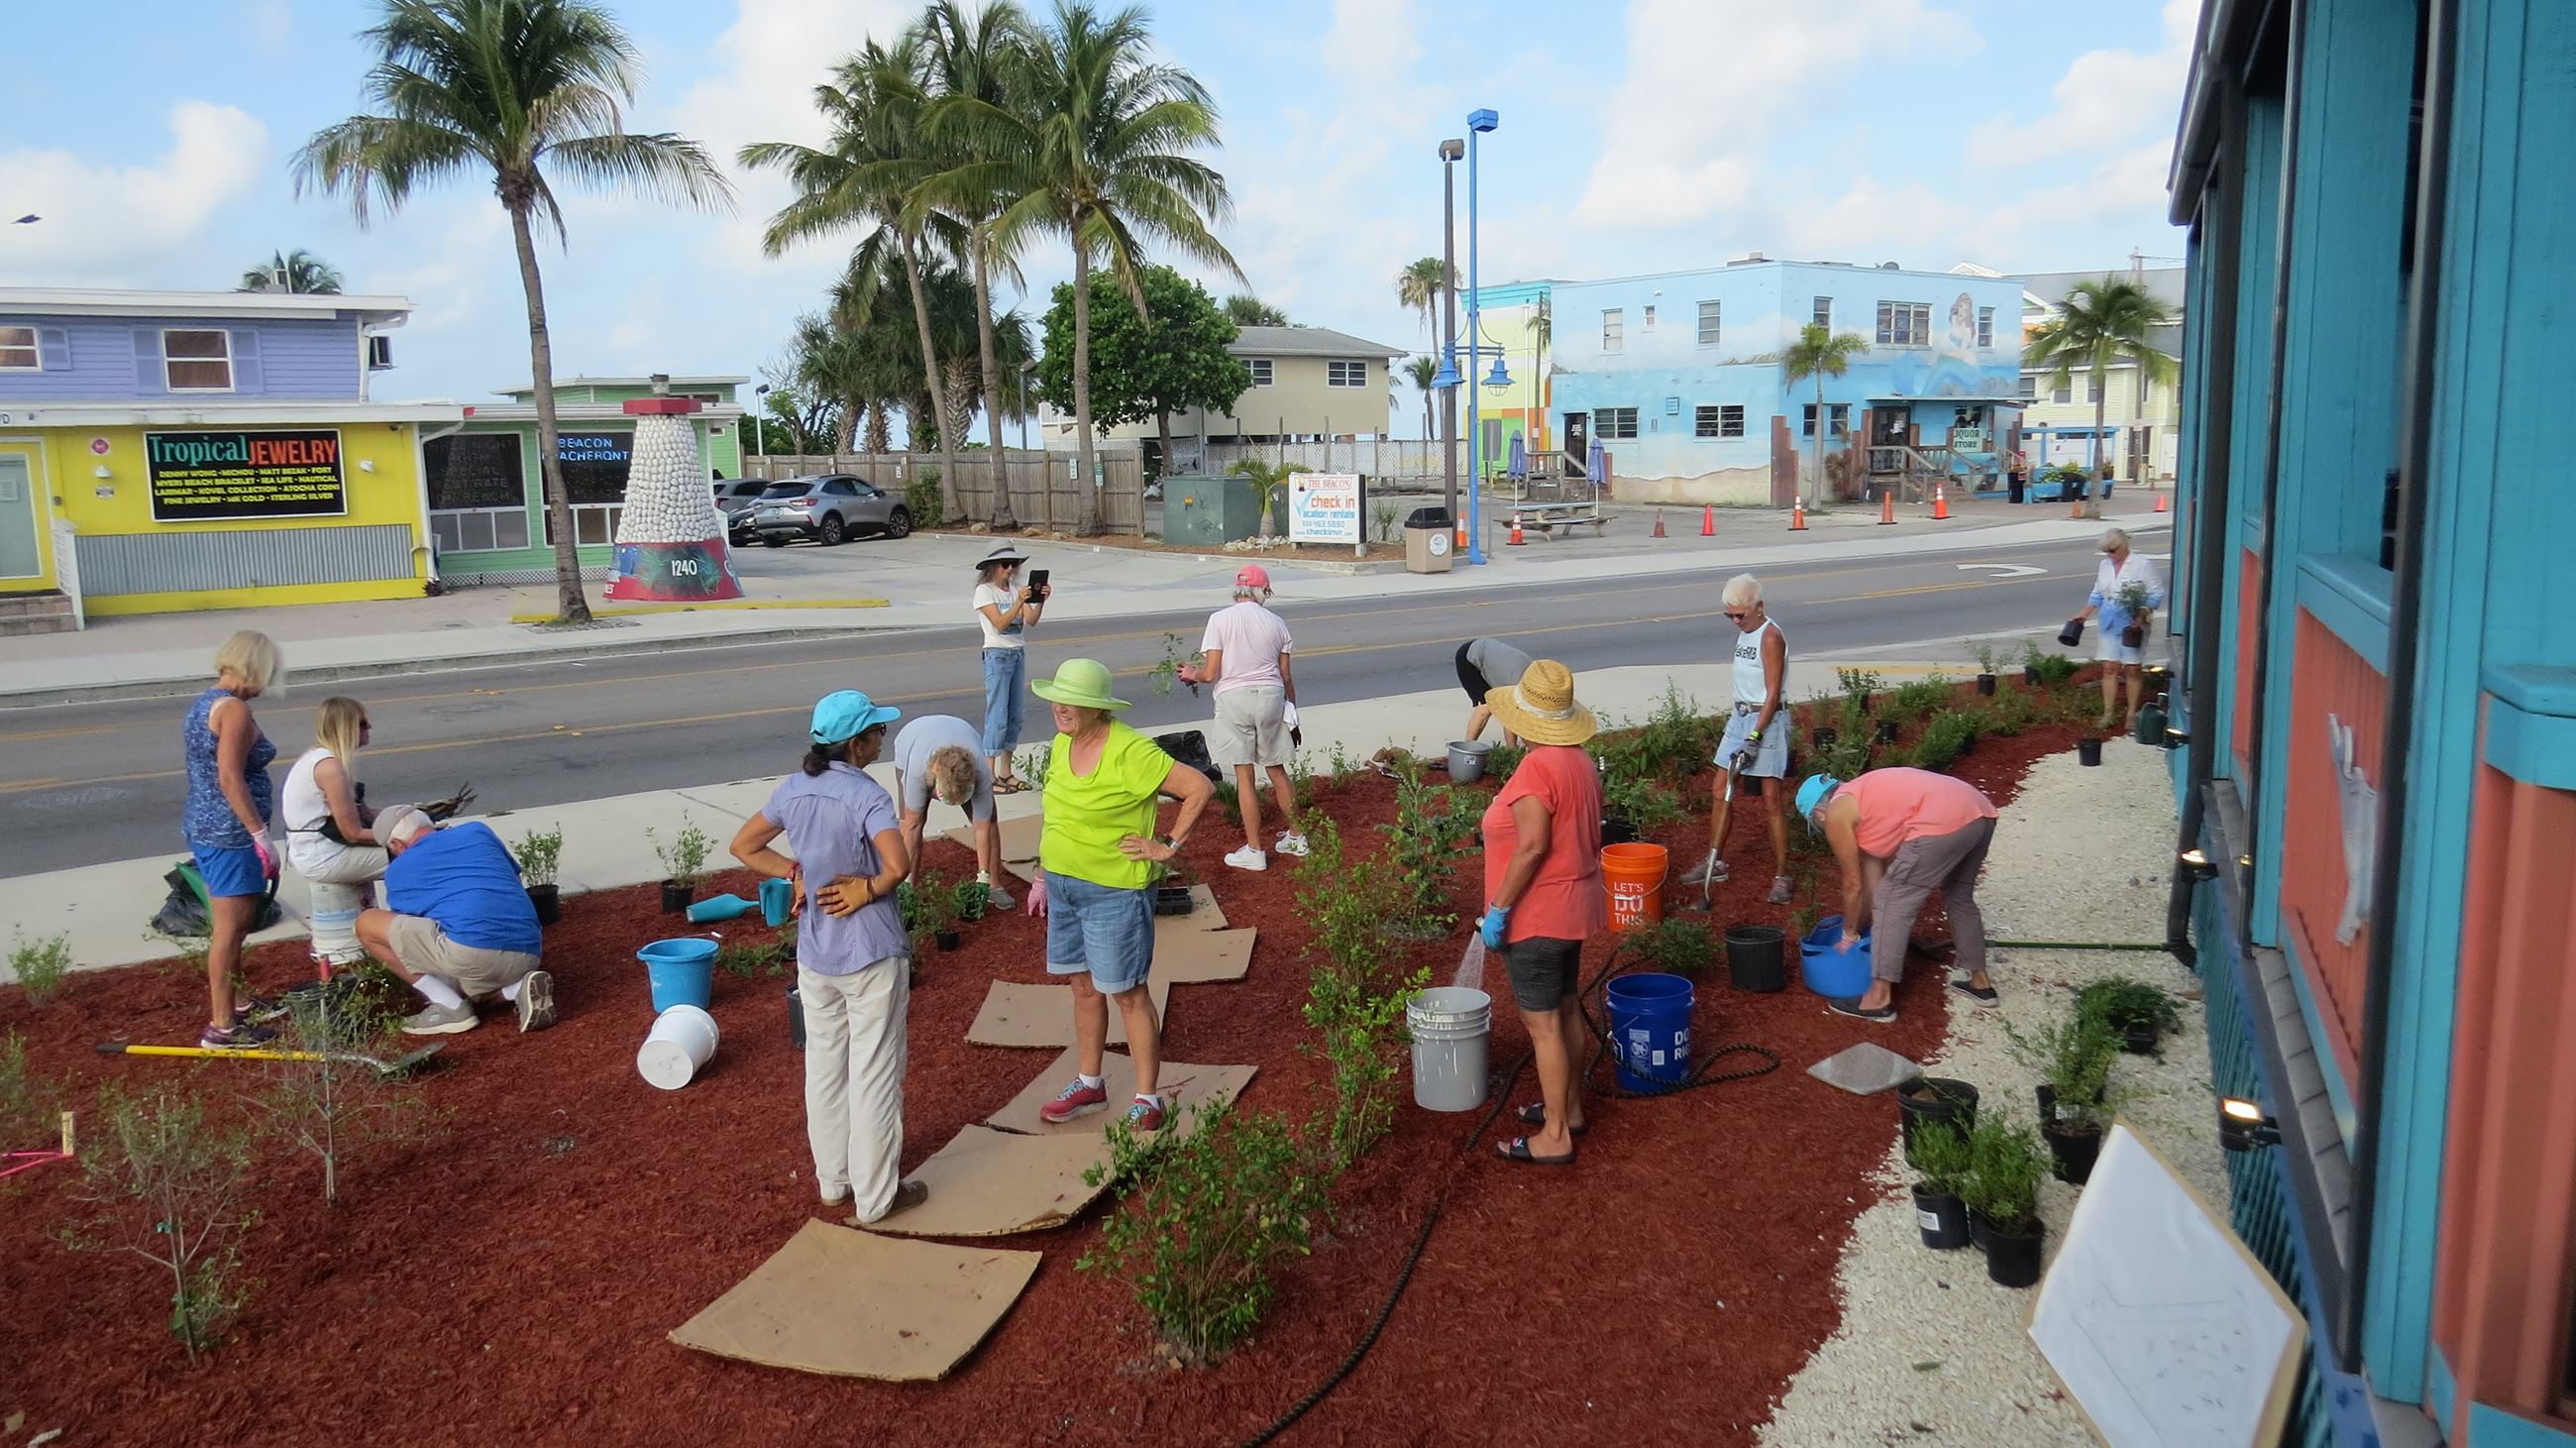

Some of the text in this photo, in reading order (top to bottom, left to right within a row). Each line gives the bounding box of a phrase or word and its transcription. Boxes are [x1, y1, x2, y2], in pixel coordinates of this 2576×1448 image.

[557, 438, 612, 448] BEACON
[149, 435, 337, 467] Tropical JEWELRY
[541, 450, 629, 461] ACHFRONT
[1308, 479, 1350, 489] THE BEACON
[1311, 495, 1355, 508] check in
[1330, 509, 1355, 518] rentals
[671, 560, 698, 576] 1240
[1614, 881, 1644, 893] LET'S
[1614, 894, 1644, 912] DO
